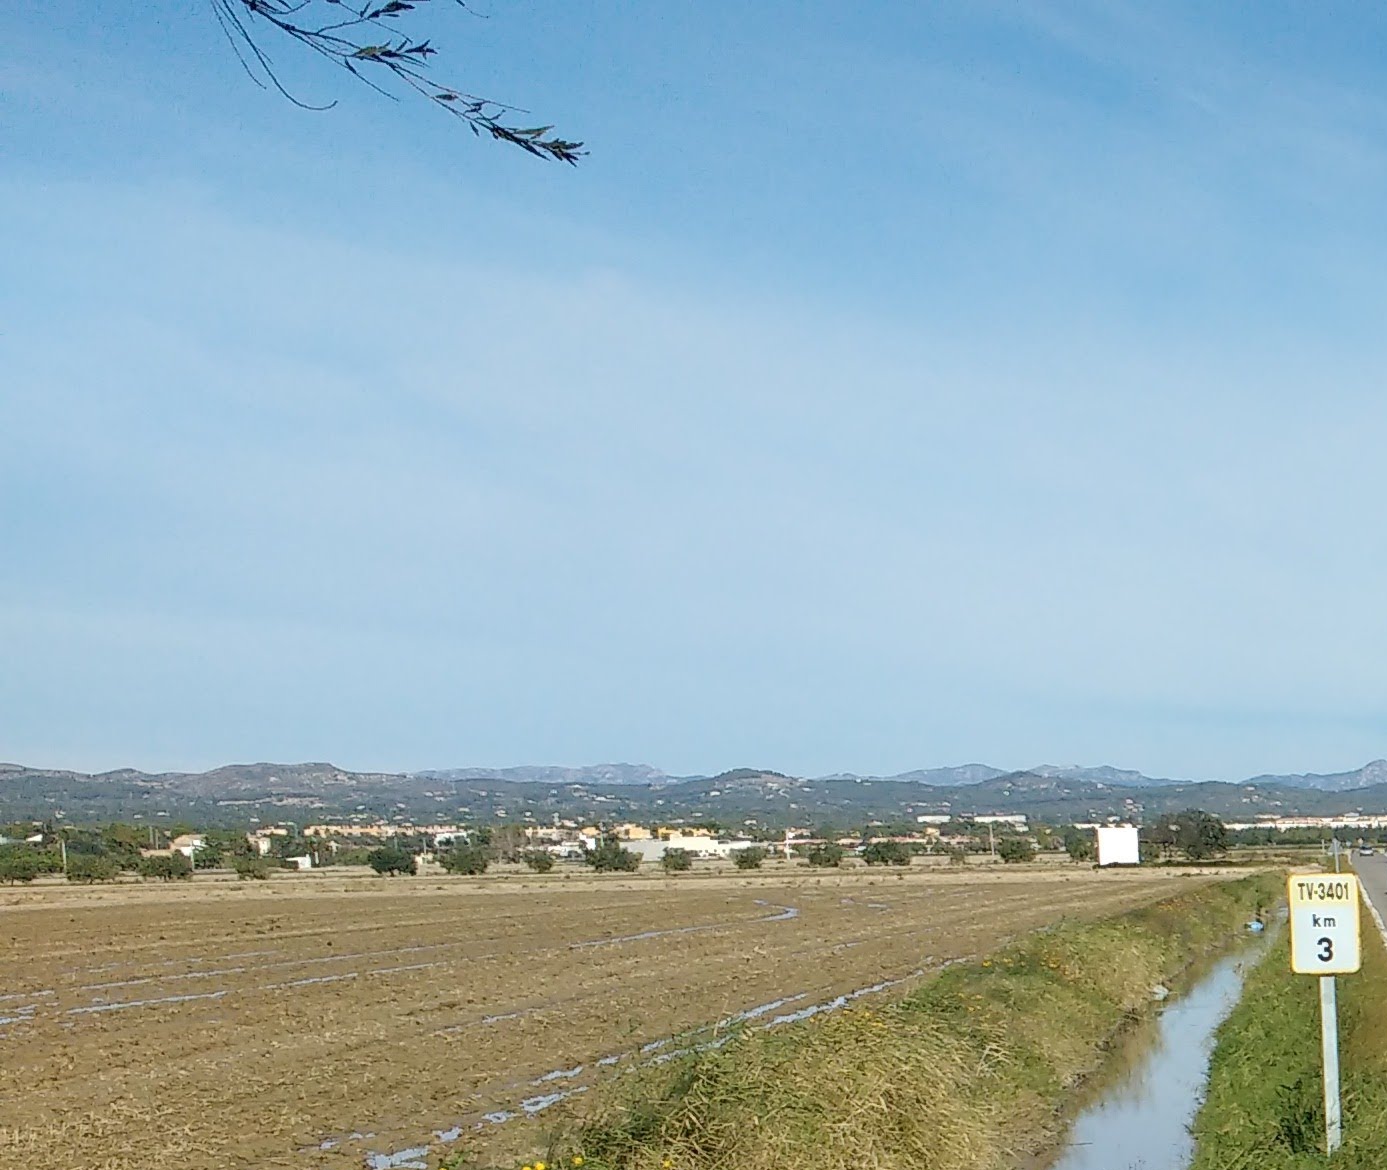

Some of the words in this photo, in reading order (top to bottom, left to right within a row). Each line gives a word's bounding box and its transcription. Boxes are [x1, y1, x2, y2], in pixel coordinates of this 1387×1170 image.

[1297, 882, 1349, 900] TV-3401
[1312, 913, 1336, 927] km
[1317, 937, 1334, 962] 3
